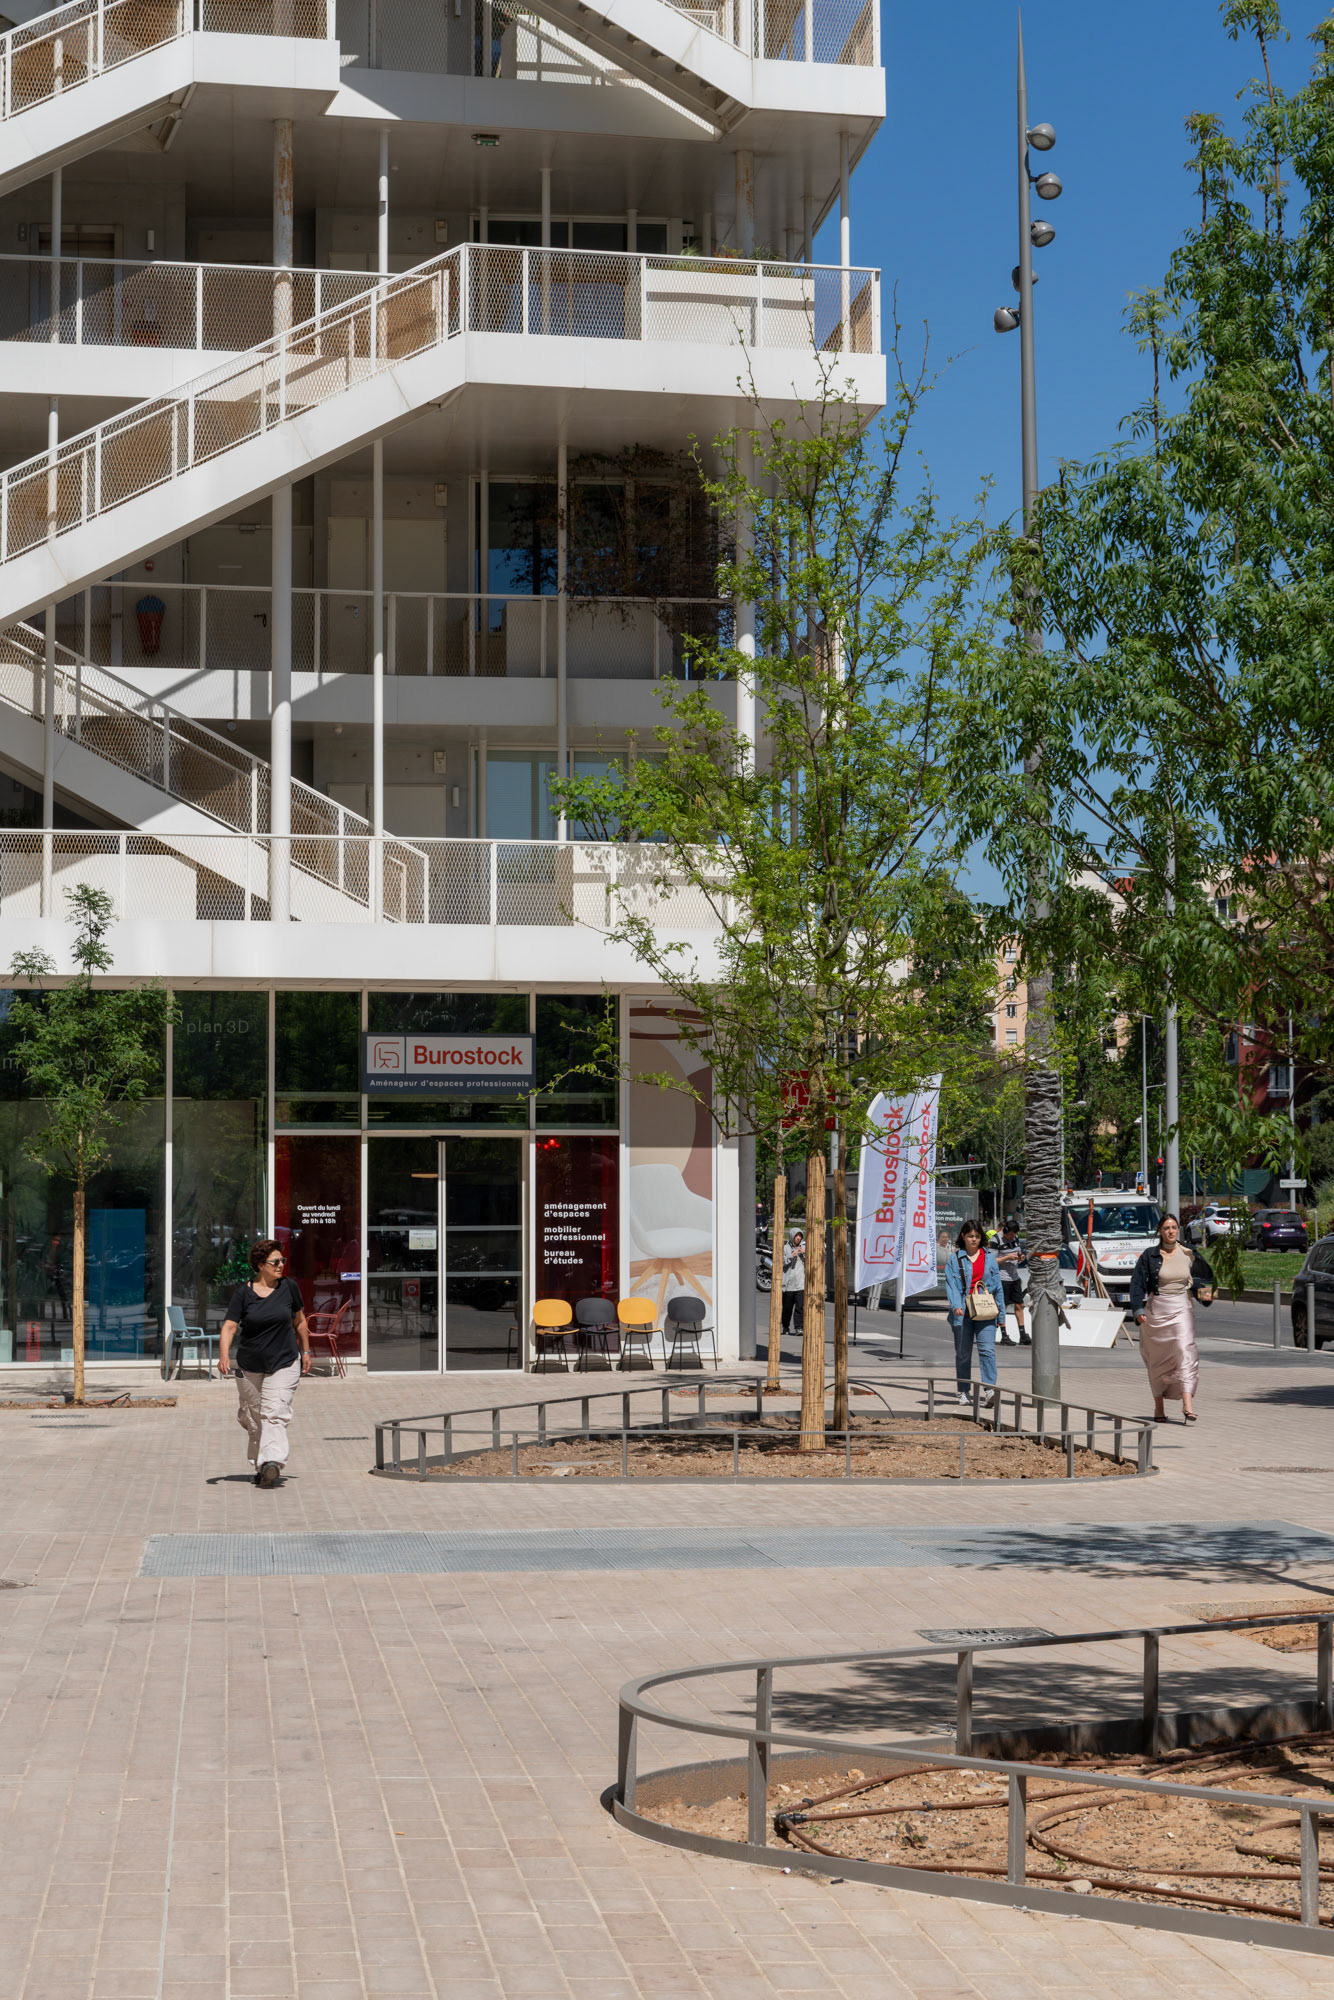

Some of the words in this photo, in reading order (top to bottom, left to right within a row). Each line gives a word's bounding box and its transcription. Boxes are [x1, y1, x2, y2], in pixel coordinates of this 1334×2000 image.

[187, 1019, 223, 1036] plan
[227, 1020, 250, 1034] 3D
[413, 1045, 523, 1065] Burostock
[370, 1079, 418, 1089] Aménageur
[421, 1079, 464, 1089] d'espaces
[467, 1080, 529, 1089] professionnels
[876, 1105, 904, 1223] Burostock
[913, 1102, 931, 1228] Burostock
[544, 1203, 607, 1211] aménagement
[544, 1210, 590, 1218] d'espaces
[544, 1233, 606, 1242] professionnel
